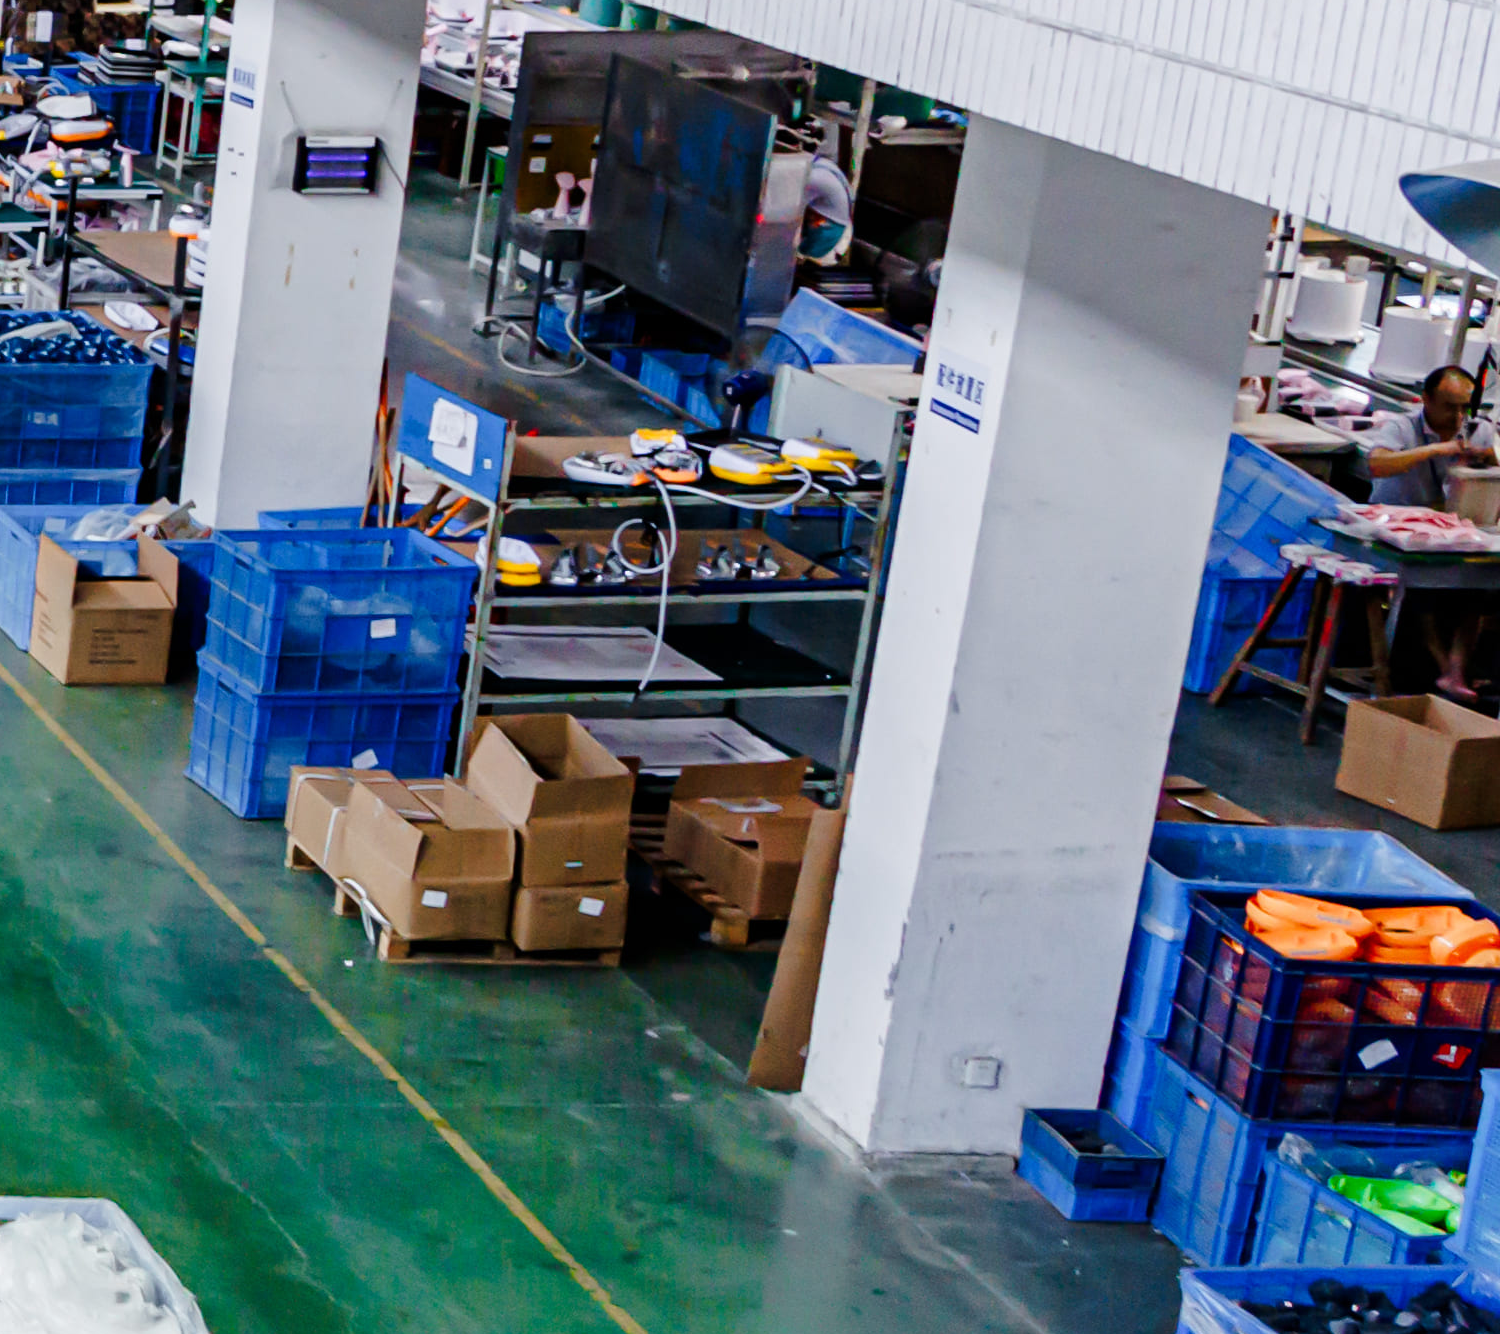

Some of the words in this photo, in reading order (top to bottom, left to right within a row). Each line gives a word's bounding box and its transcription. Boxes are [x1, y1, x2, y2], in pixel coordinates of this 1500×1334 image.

[936, 362, 985, 405] 配件放置区
